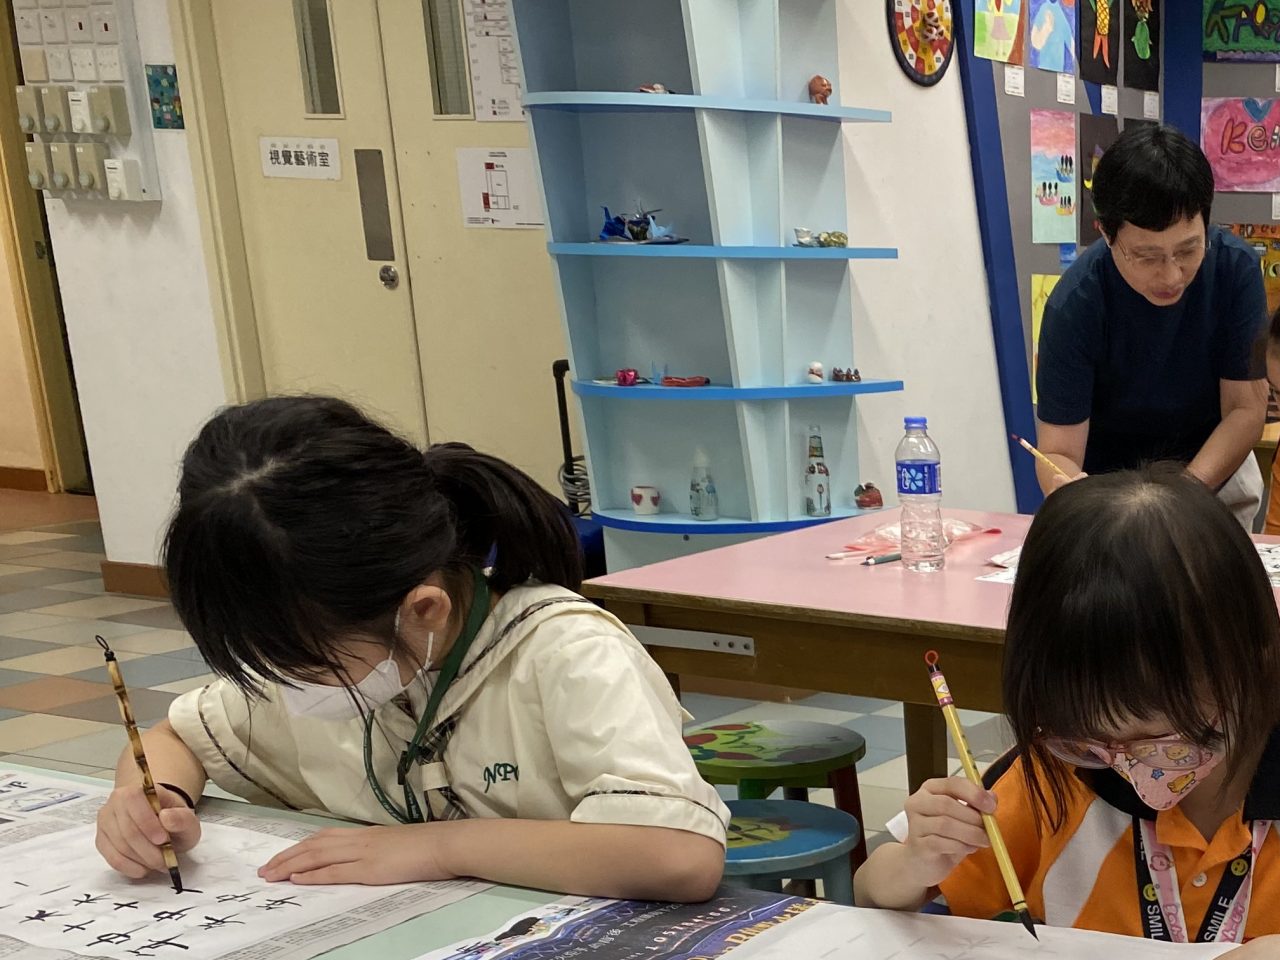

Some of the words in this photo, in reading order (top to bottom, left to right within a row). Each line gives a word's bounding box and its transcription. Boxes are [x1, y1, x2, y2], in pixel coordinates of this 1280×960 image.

[269, 149, 330, 168] 視覺藝術室
[1146, 904, 1165, 941] SMIL
[1203, 896, 1233, 943] SMILE
